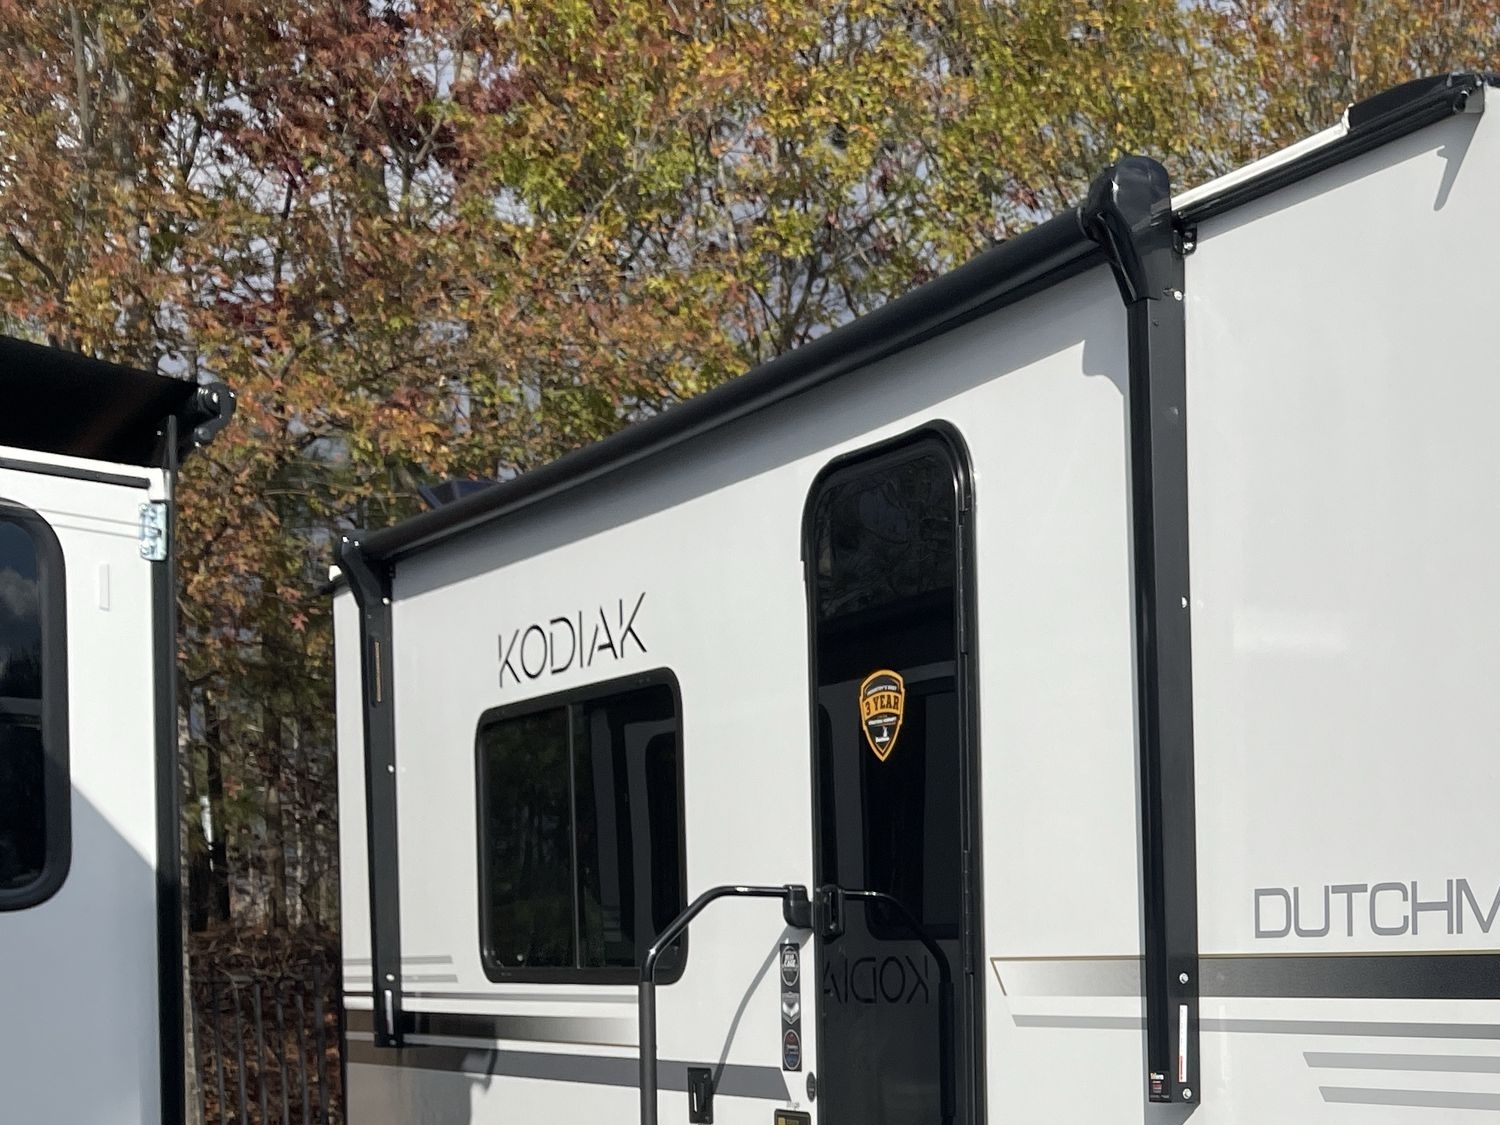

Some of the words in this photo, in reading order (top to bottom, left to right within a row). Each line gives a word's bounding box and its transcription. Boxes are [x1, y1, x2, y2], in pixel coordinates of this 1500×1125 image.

[498, 592, 647, 688] KODIAK
[864, 701, 871, 716] 3
[873, 694, 900, 711] YEAR
